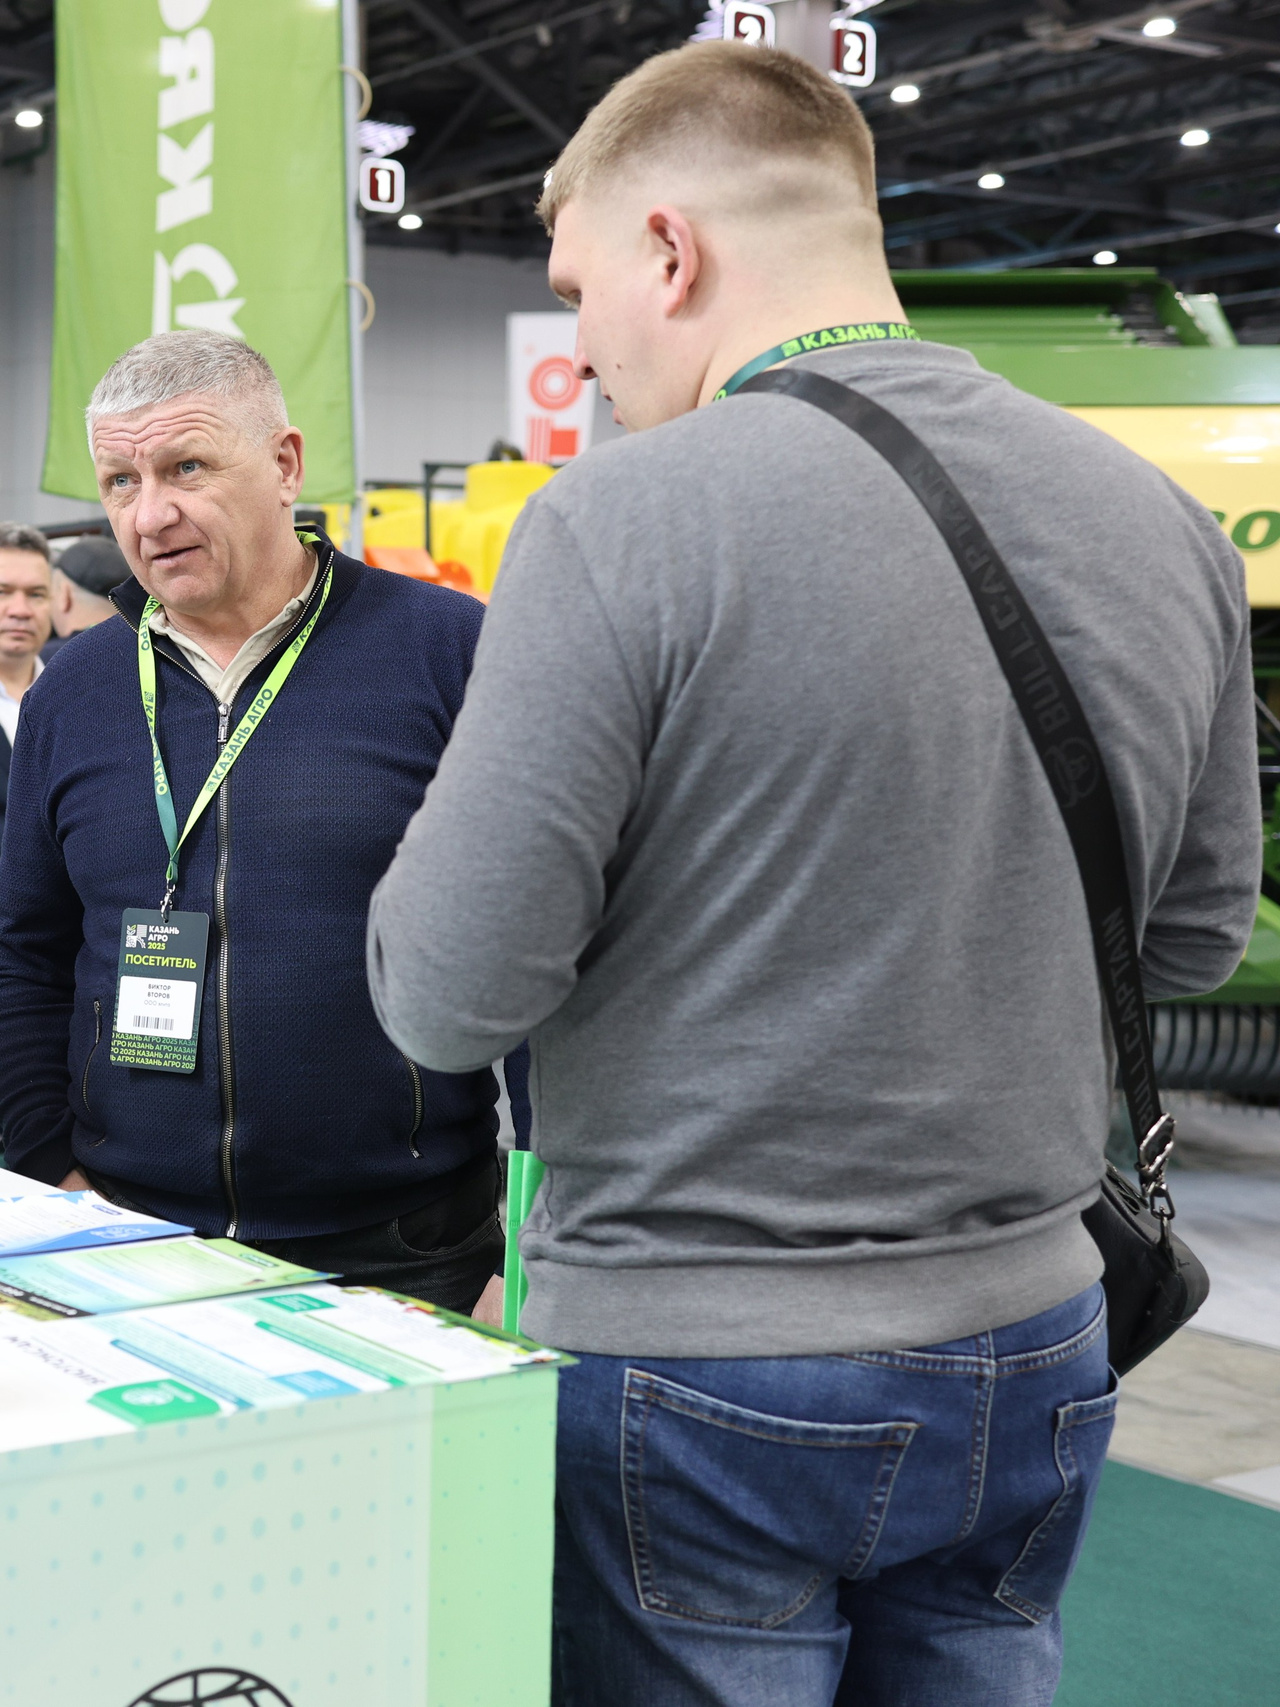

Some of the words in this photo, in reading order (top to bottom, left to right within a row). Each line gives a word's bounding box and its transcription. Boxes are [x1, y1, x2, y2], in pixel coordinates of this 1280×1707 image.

[843, 33, 863, 73] 2
[375, 169, 391, 202] 1
[801, 323, 886, 350] КАЗАНЬ
[213, 726, 251, 780] КАЗАНЬ
[247, 688, 273, 724] АГРО
[149, 925, 180, 935] КАЗАНЬ
[148, 934, 168, 942] АГРО
[148, 942, 166, 950] 2025
[125, 953, 197, 969] ПОСЕТИТЕЛЬ
[148, 983, 172, 991] ВИКТОР
[147, 991, 170, 999] ВТОРОВ
[116, 1033, 143, 1041] КАЗАНЬ
[127, 1041, 154, 1049] КАЗАНЬ
[136, 1050, 163, 1058] КАЗАНЬ
[117, 1055, 135, 1063] АГРО
[135, 1057, 162, 1066] КАЗАНЬ
[163, 1060, 181, 1068] АГРО
